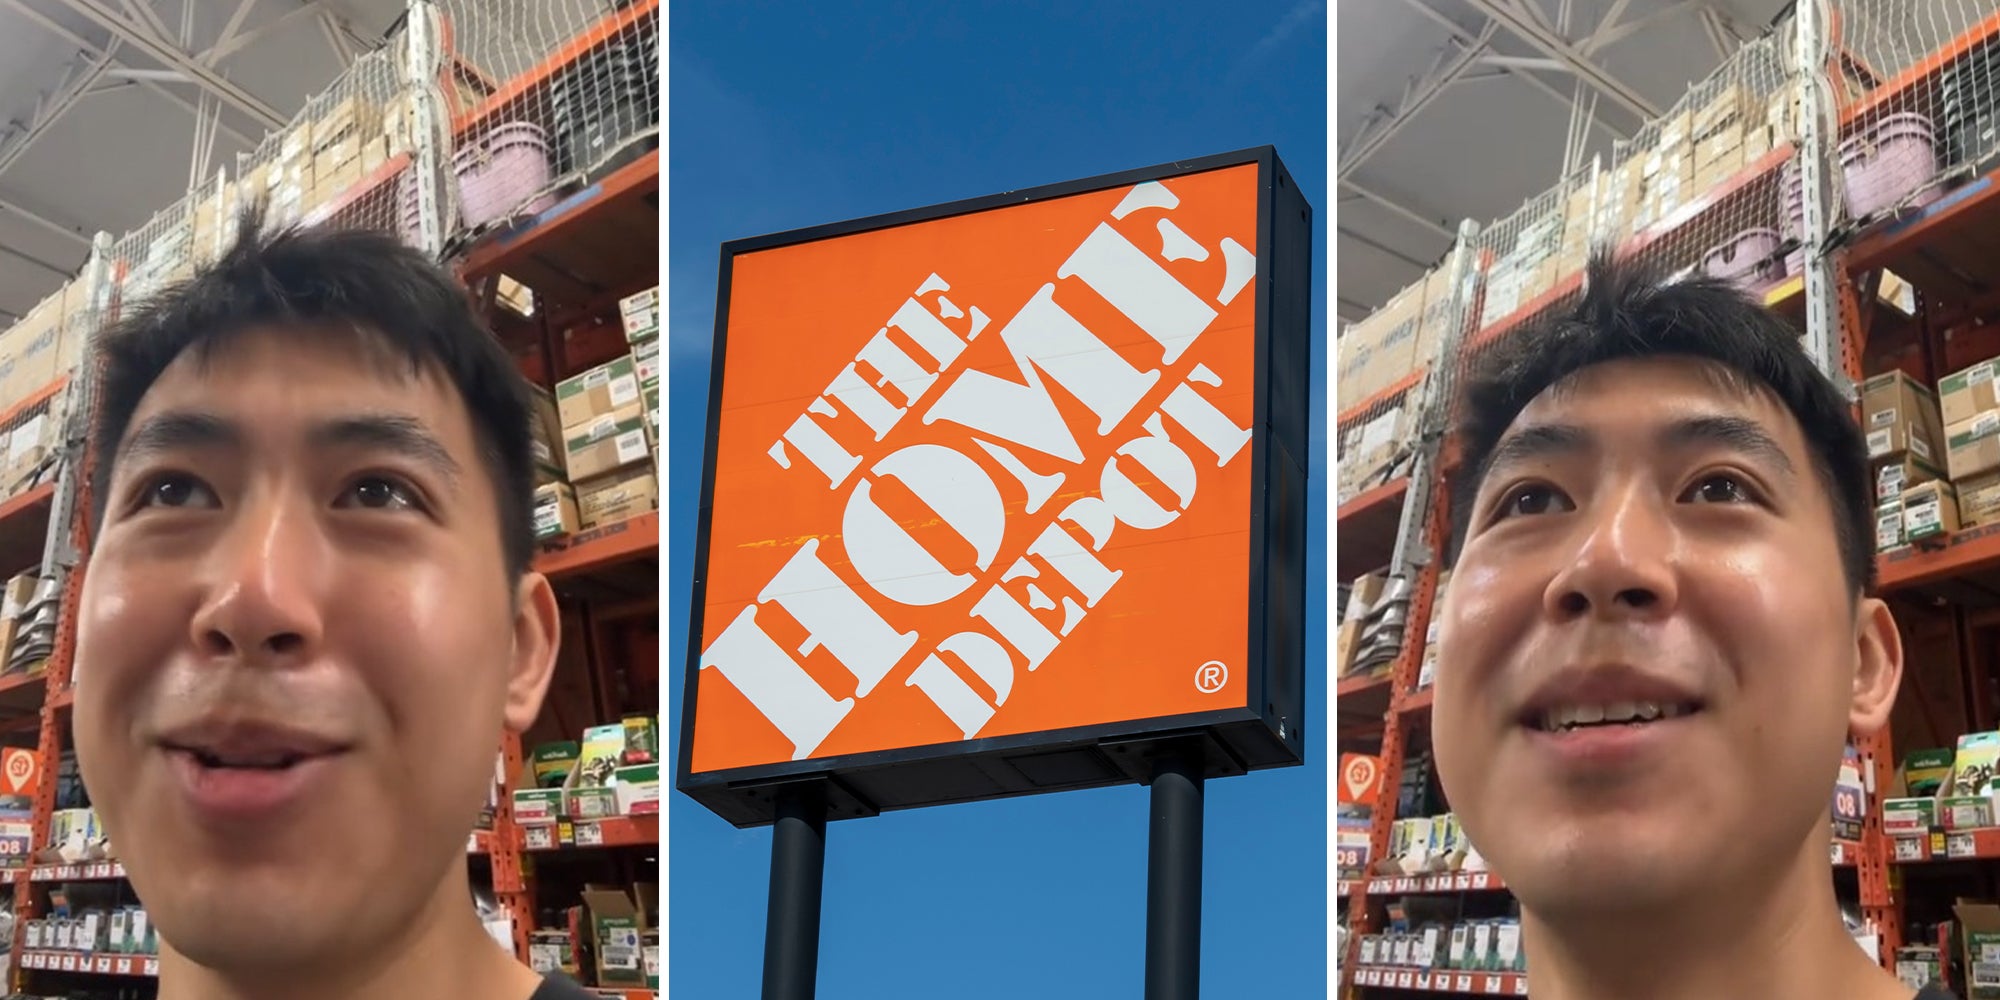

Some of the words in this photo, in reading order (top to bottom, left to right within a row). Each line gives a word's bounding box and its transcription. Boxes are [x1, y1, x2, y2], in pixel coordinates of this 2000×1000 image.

[700, 181, 1257, 761] HOME
[768, 273, 991, 489] THE
[905, 363, 1252, 740] DEPOT
